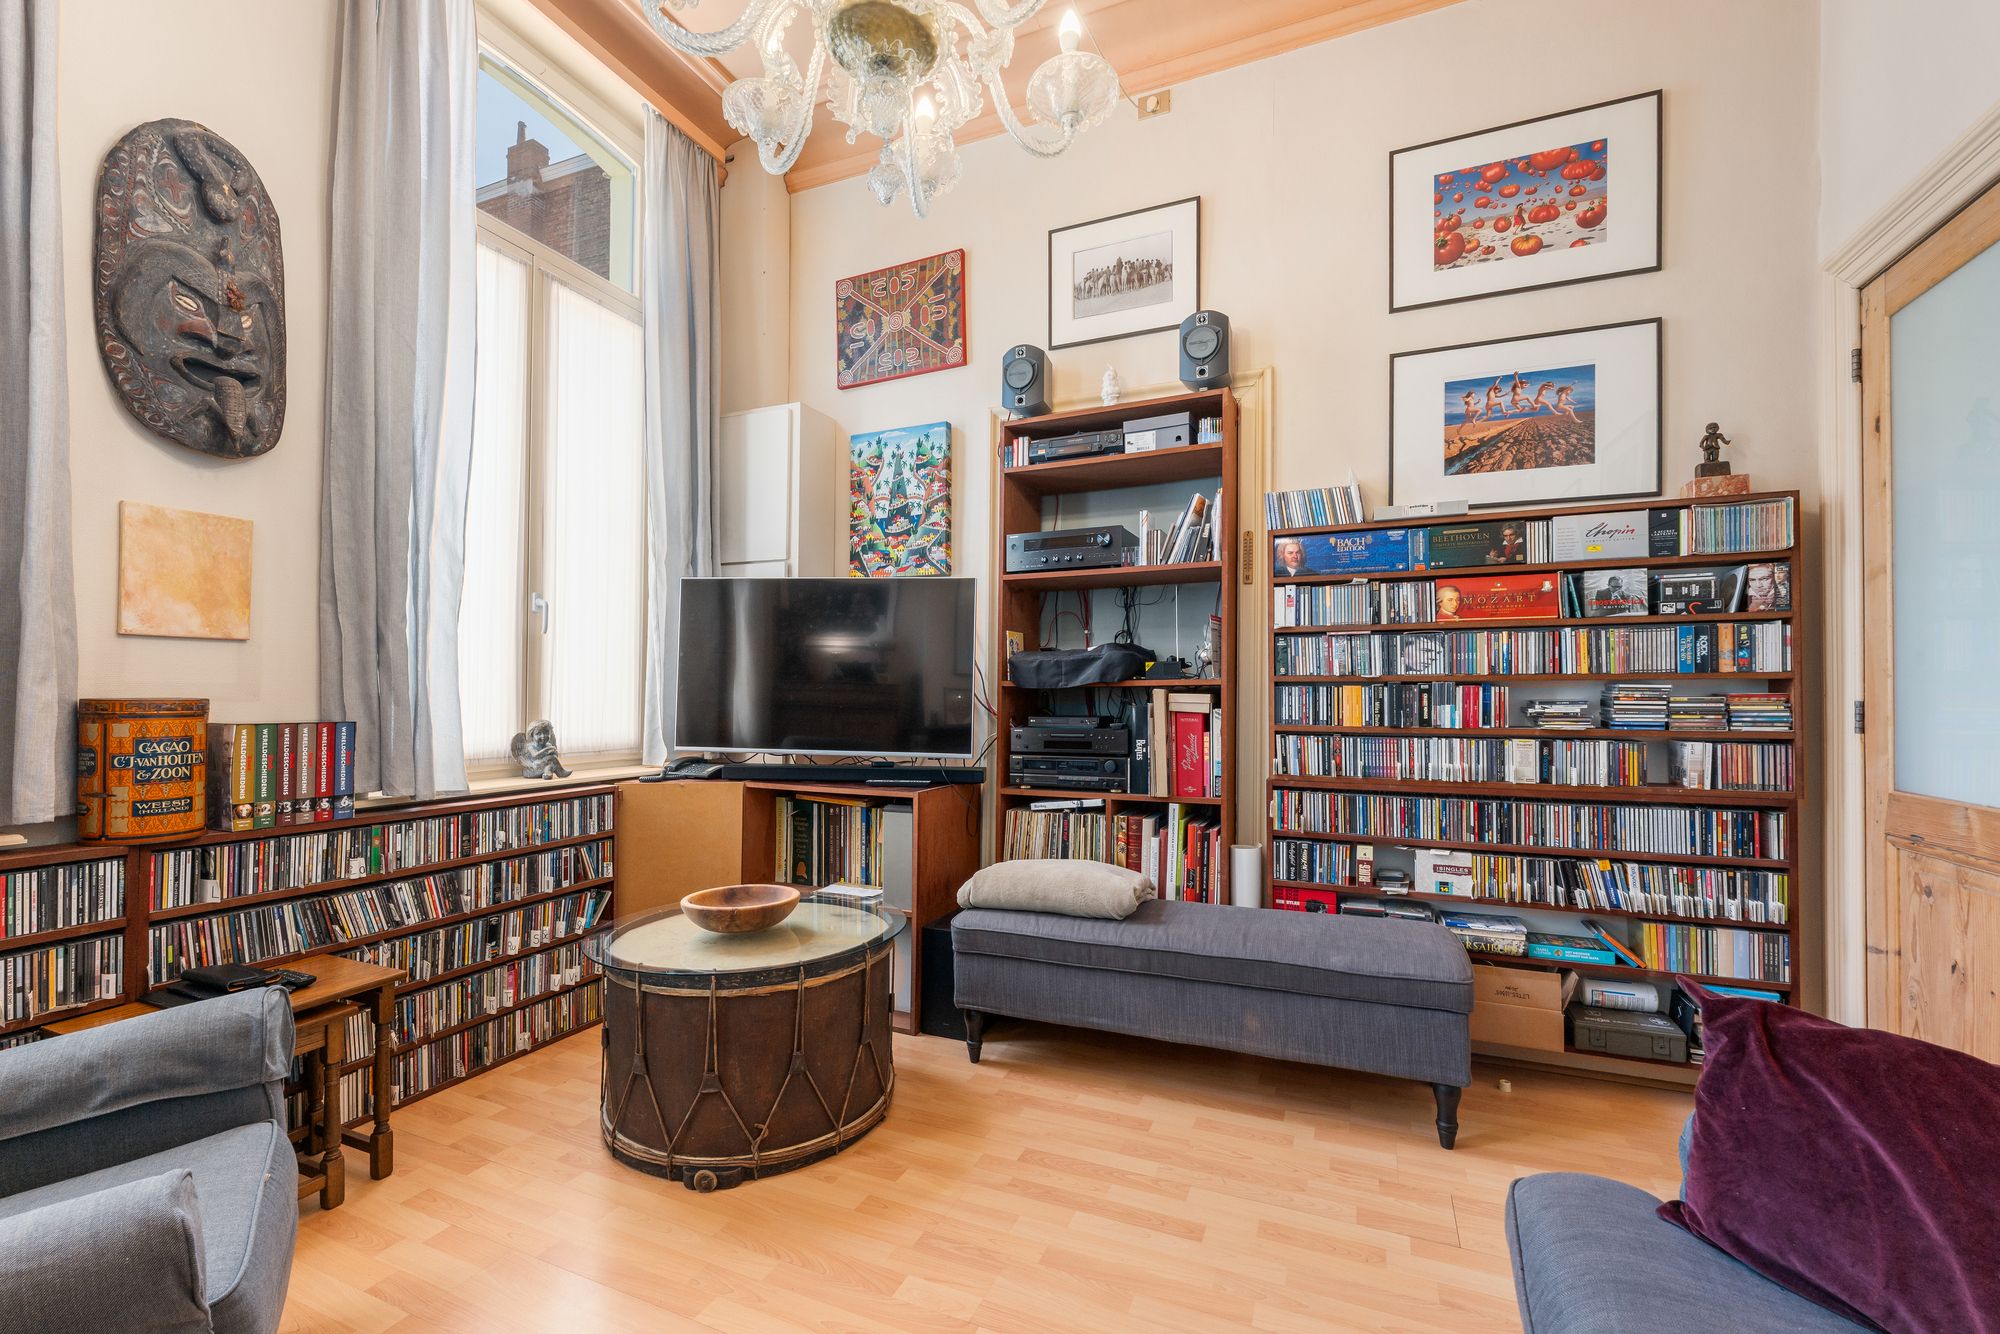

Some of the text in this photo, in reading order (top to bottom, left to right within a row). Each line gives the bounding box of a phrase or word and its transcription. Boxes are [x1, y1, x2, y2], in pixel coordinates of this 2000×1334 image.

[1585, 522, 1635, 538] Chopin
[1337, 537, 1365, 547] BACH
[1432, 532, 1490, 543] BEETHOVEN
[1463, 594, 1536, 605] MOZART
[1700, 635, 1708, 656] ROCK
[138, 740, 190, 754] CACAO
[1135, 739, 1146, 761] BEATLES
[157, 752, 204, 766] HOUTEN
[239, 728, 248, 800] WERELDGESCHIEDENIS
[261, 728, 269, 798] WERELDGESCHIEDENIS
[282, 727, 290, 796] WERELDGESCHIEDENIS
[320, 726, 328, 792] WERELDGESCHIEDENIS
[137, 767, 191, 781] & ZOON
[135, 798, 190, 810] WEESP
[138, 806, 190, 815] (HOLLAND)
[1358, 864, 1371, 883] BLUES
[1438, 866, 1469, 874] SINGLES
[533, 934, 540, 945] S
[1465, 941, 1519, 955] RSAILLES
[569, 973, 575, 981] V
